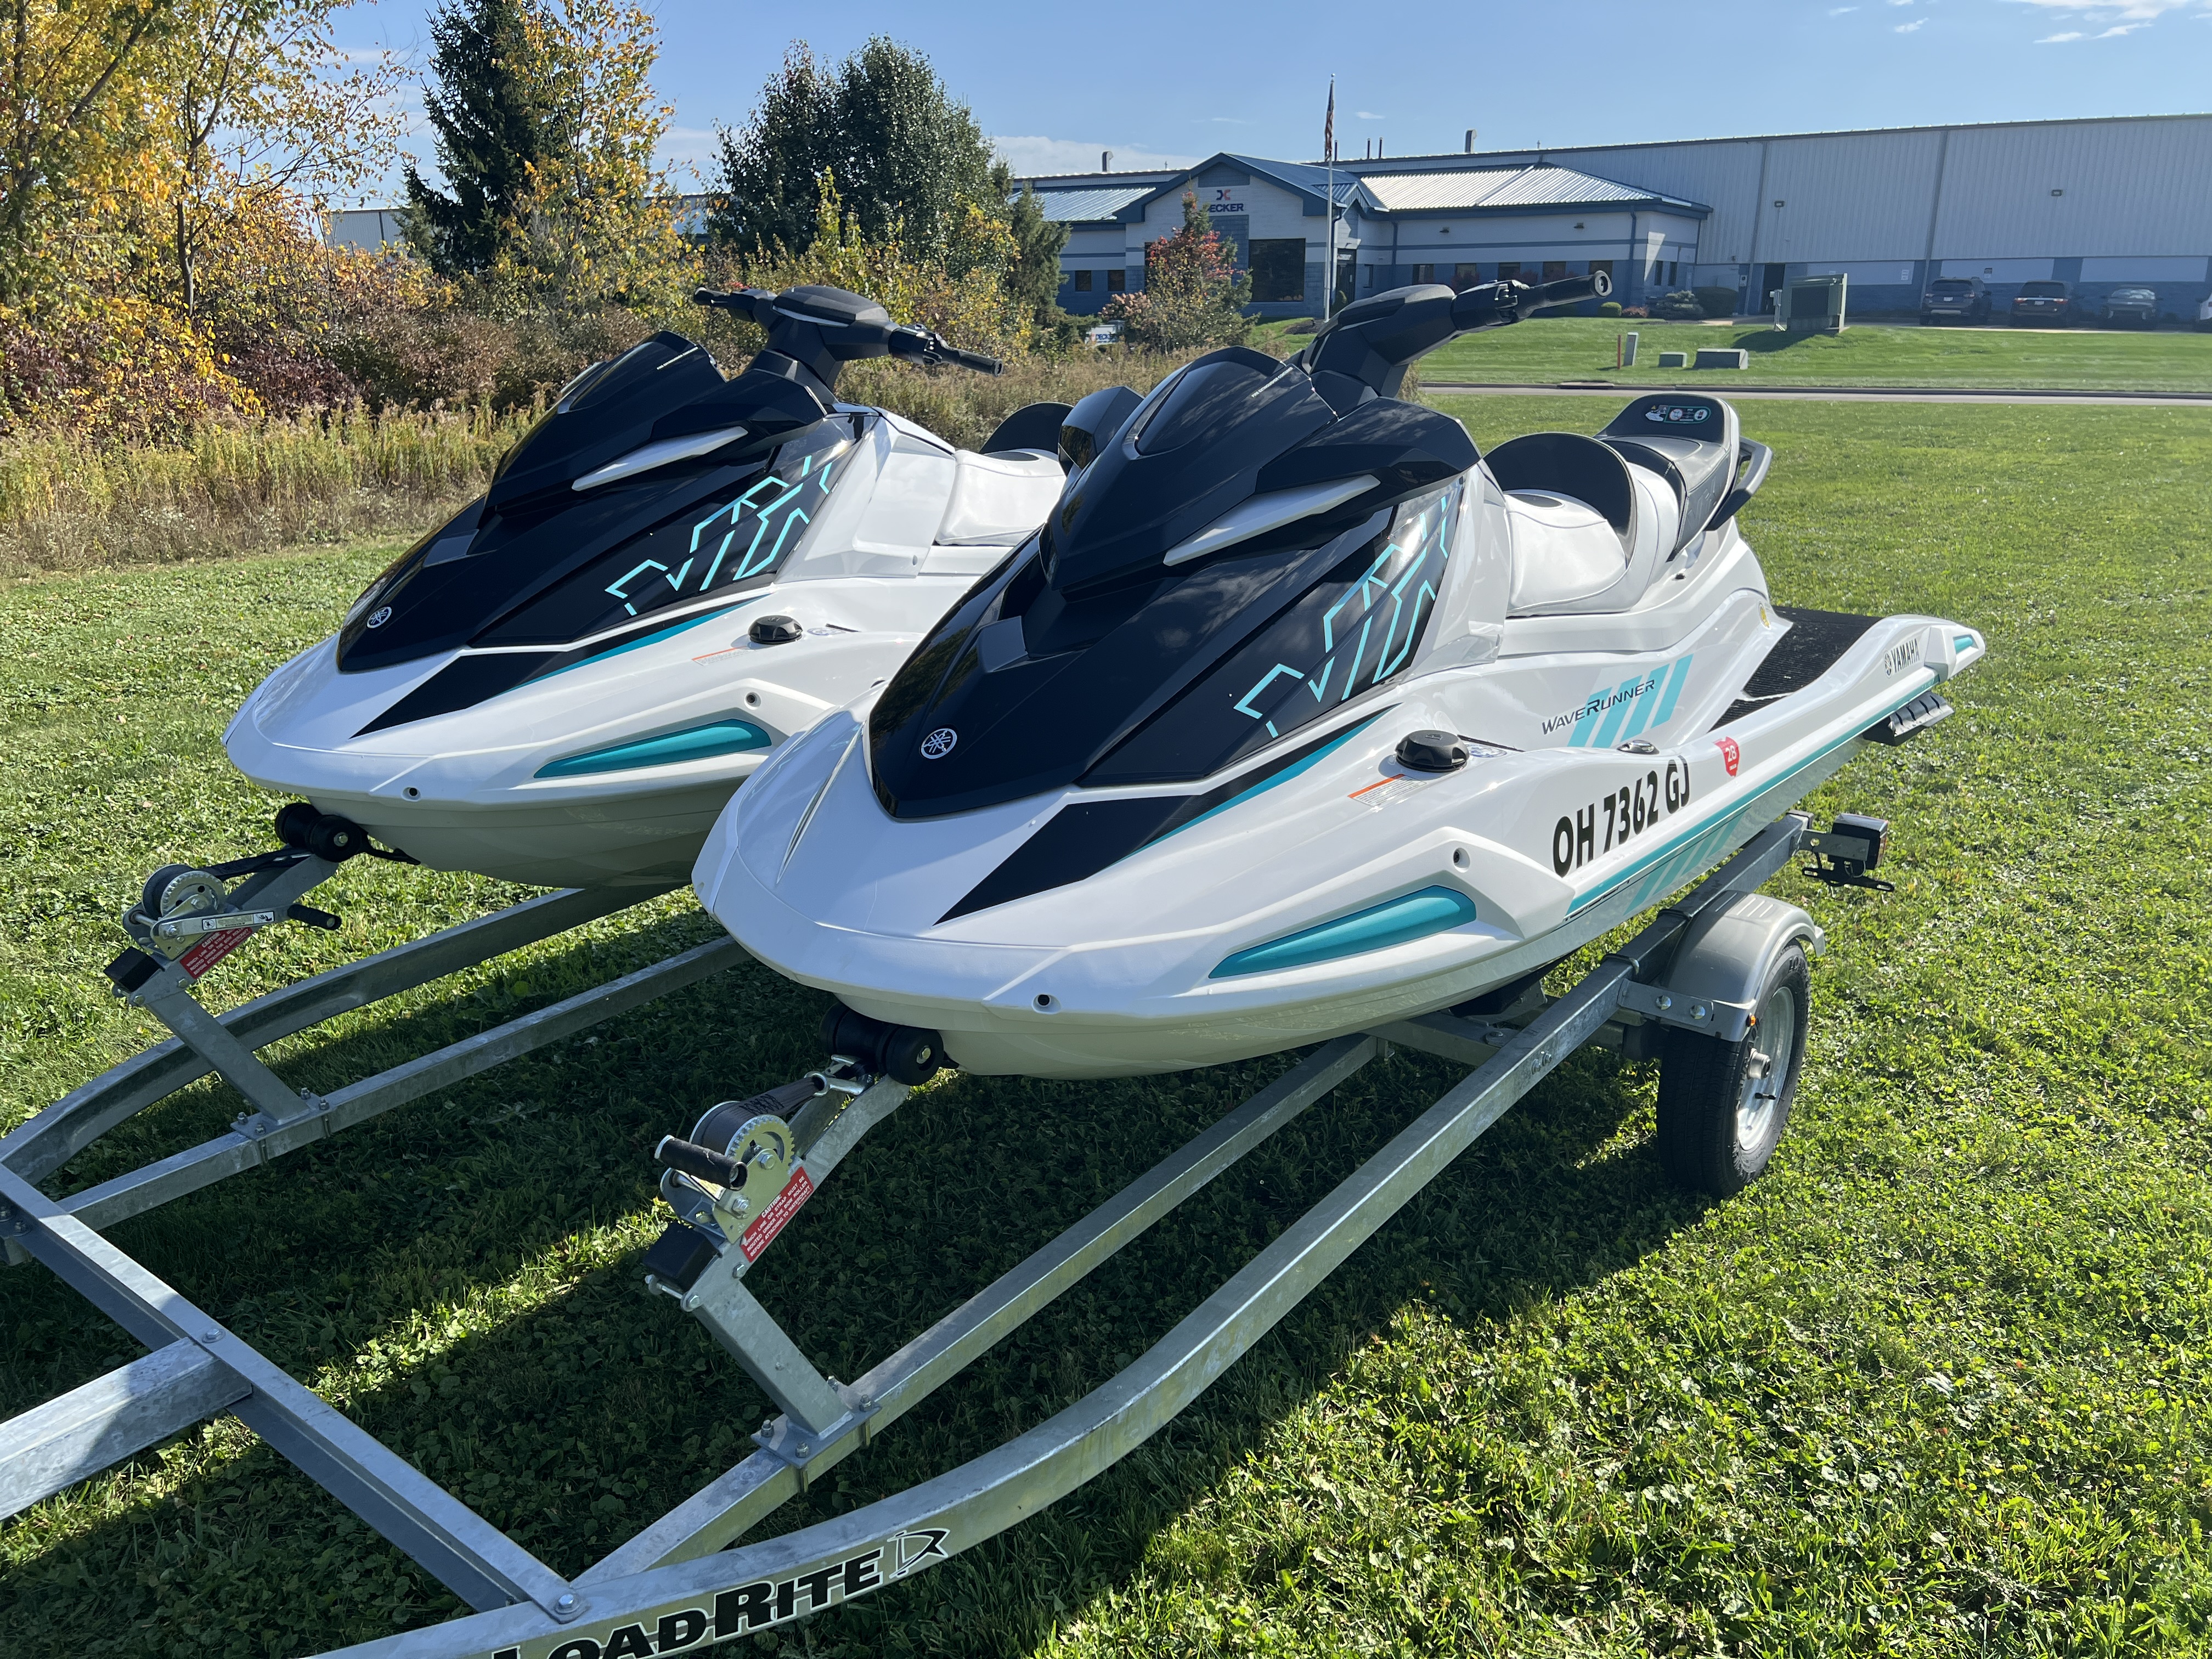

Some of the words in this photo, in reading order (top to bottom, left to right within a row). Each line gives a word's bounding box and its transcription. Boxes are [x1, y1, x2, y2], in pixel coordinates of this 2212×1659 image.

[1207, 203, 1244, 212] ECKER
[1891, 638, 1920, 673] YAMAHA
[1725, 745, 1737, 763] 28
[1553, 803, 1595, 878] OH
[1603, 770, 1658, 854] 7362
[1666, 755, 1690, 814] GJ
[747, 1233, 763, 1252] ROUTED
[763, 1218, 776, 1234] UNDER
[775, 1209, 784, 1218] THE
[783, 1198, 793, 1209] BOW
[793, 1181, 808, 1198] ROLLER
[750, 1240, 765, 1257] BEFORE
[764, 1217, 783, 1240] ATTACHING
[788, 1185, 811, 1212] WATERCRAFT
[757, 1220, 768, 1232] LINE
[767, 1212, 774, 1220] OR
[774, 1196, 787, 1212] STRAP
[787, 1183, 798, 1197] MUST
[798, 1175, 805, 1183] BE
[761, 1194, 782, 1218] CAUTION:
